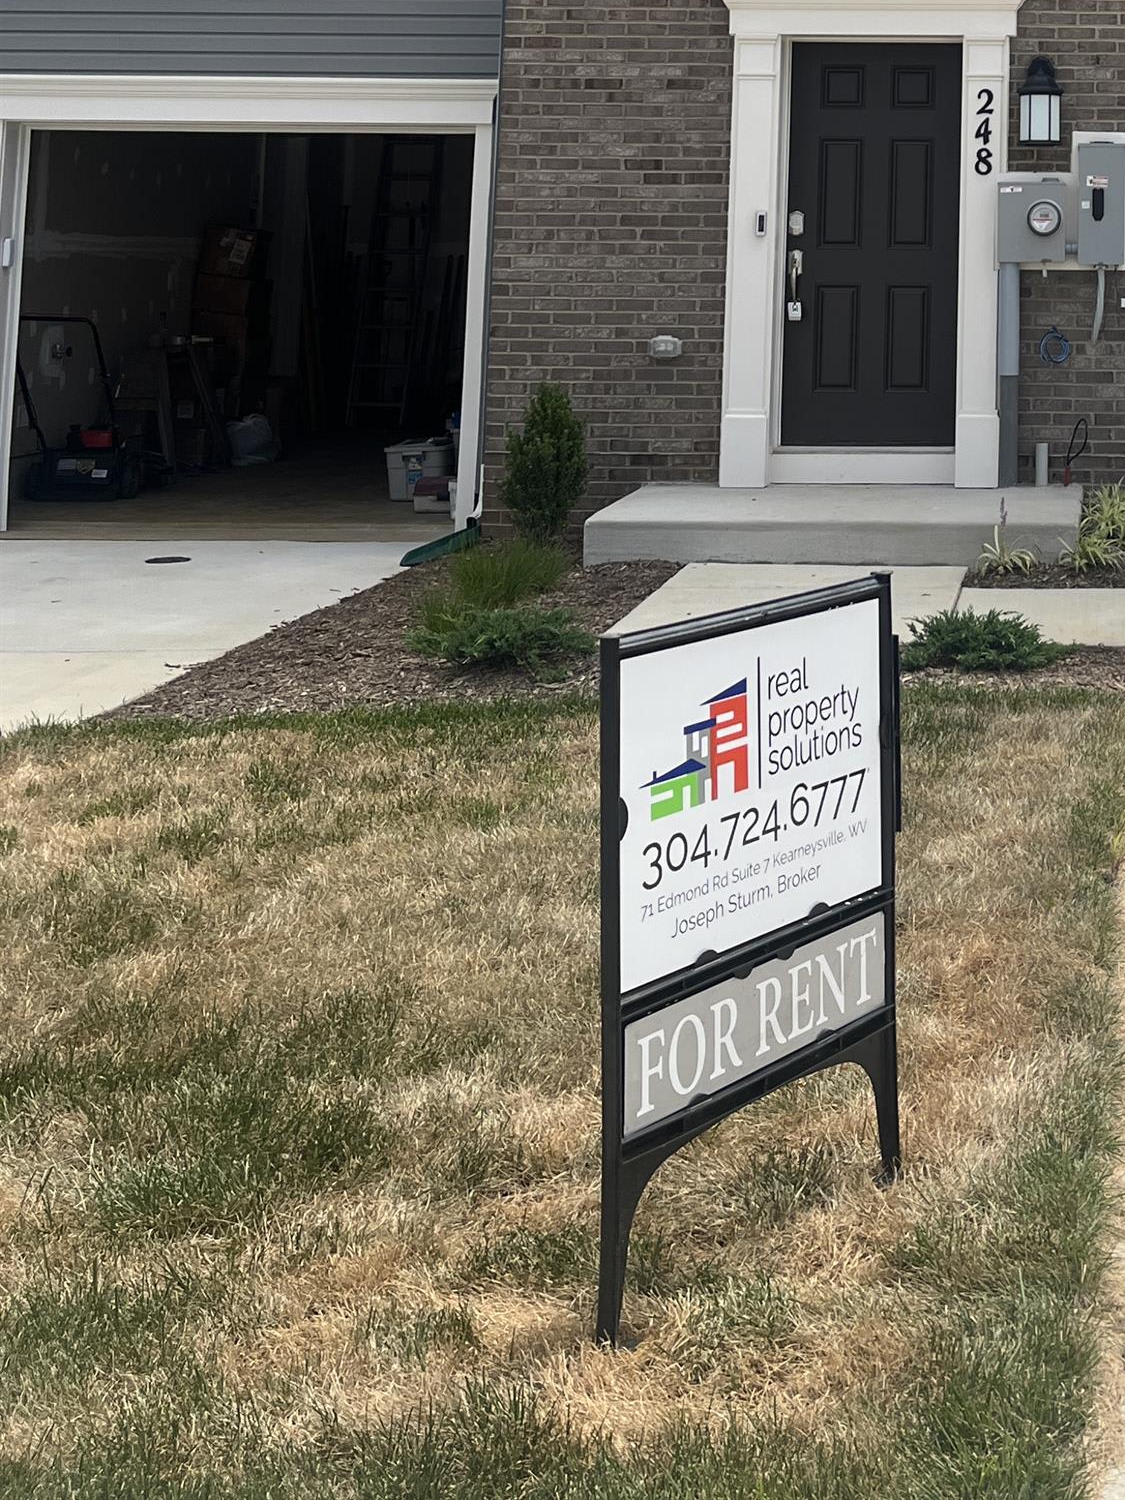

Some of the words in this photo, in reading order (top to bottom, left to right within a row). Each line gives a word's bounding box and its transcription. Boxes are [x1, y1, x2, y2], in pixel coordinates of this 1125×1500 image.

[974, 88, 994, 176] 248
[768, 656, 809, 701] real
[768, 684, 860, 748] property
[768, 725, 863, 776] solutions
[642, 767, 867, 890] 304.724.6777
[640, 903, 655, 923] 71
[656, 878, 710, 914] Edmond
[712, 871, 730, 892] Rd
[731, 862, 761, 885] Suite
[763, 857, 771, 875] 7
[848, 817, 868, 838] WV
[671, 901, 725, 939] Joseph
[777, 864, 822, 895] Broker
[636, 997, 743, 1118] FOR
[755, 927, 878, 1057] RENT
